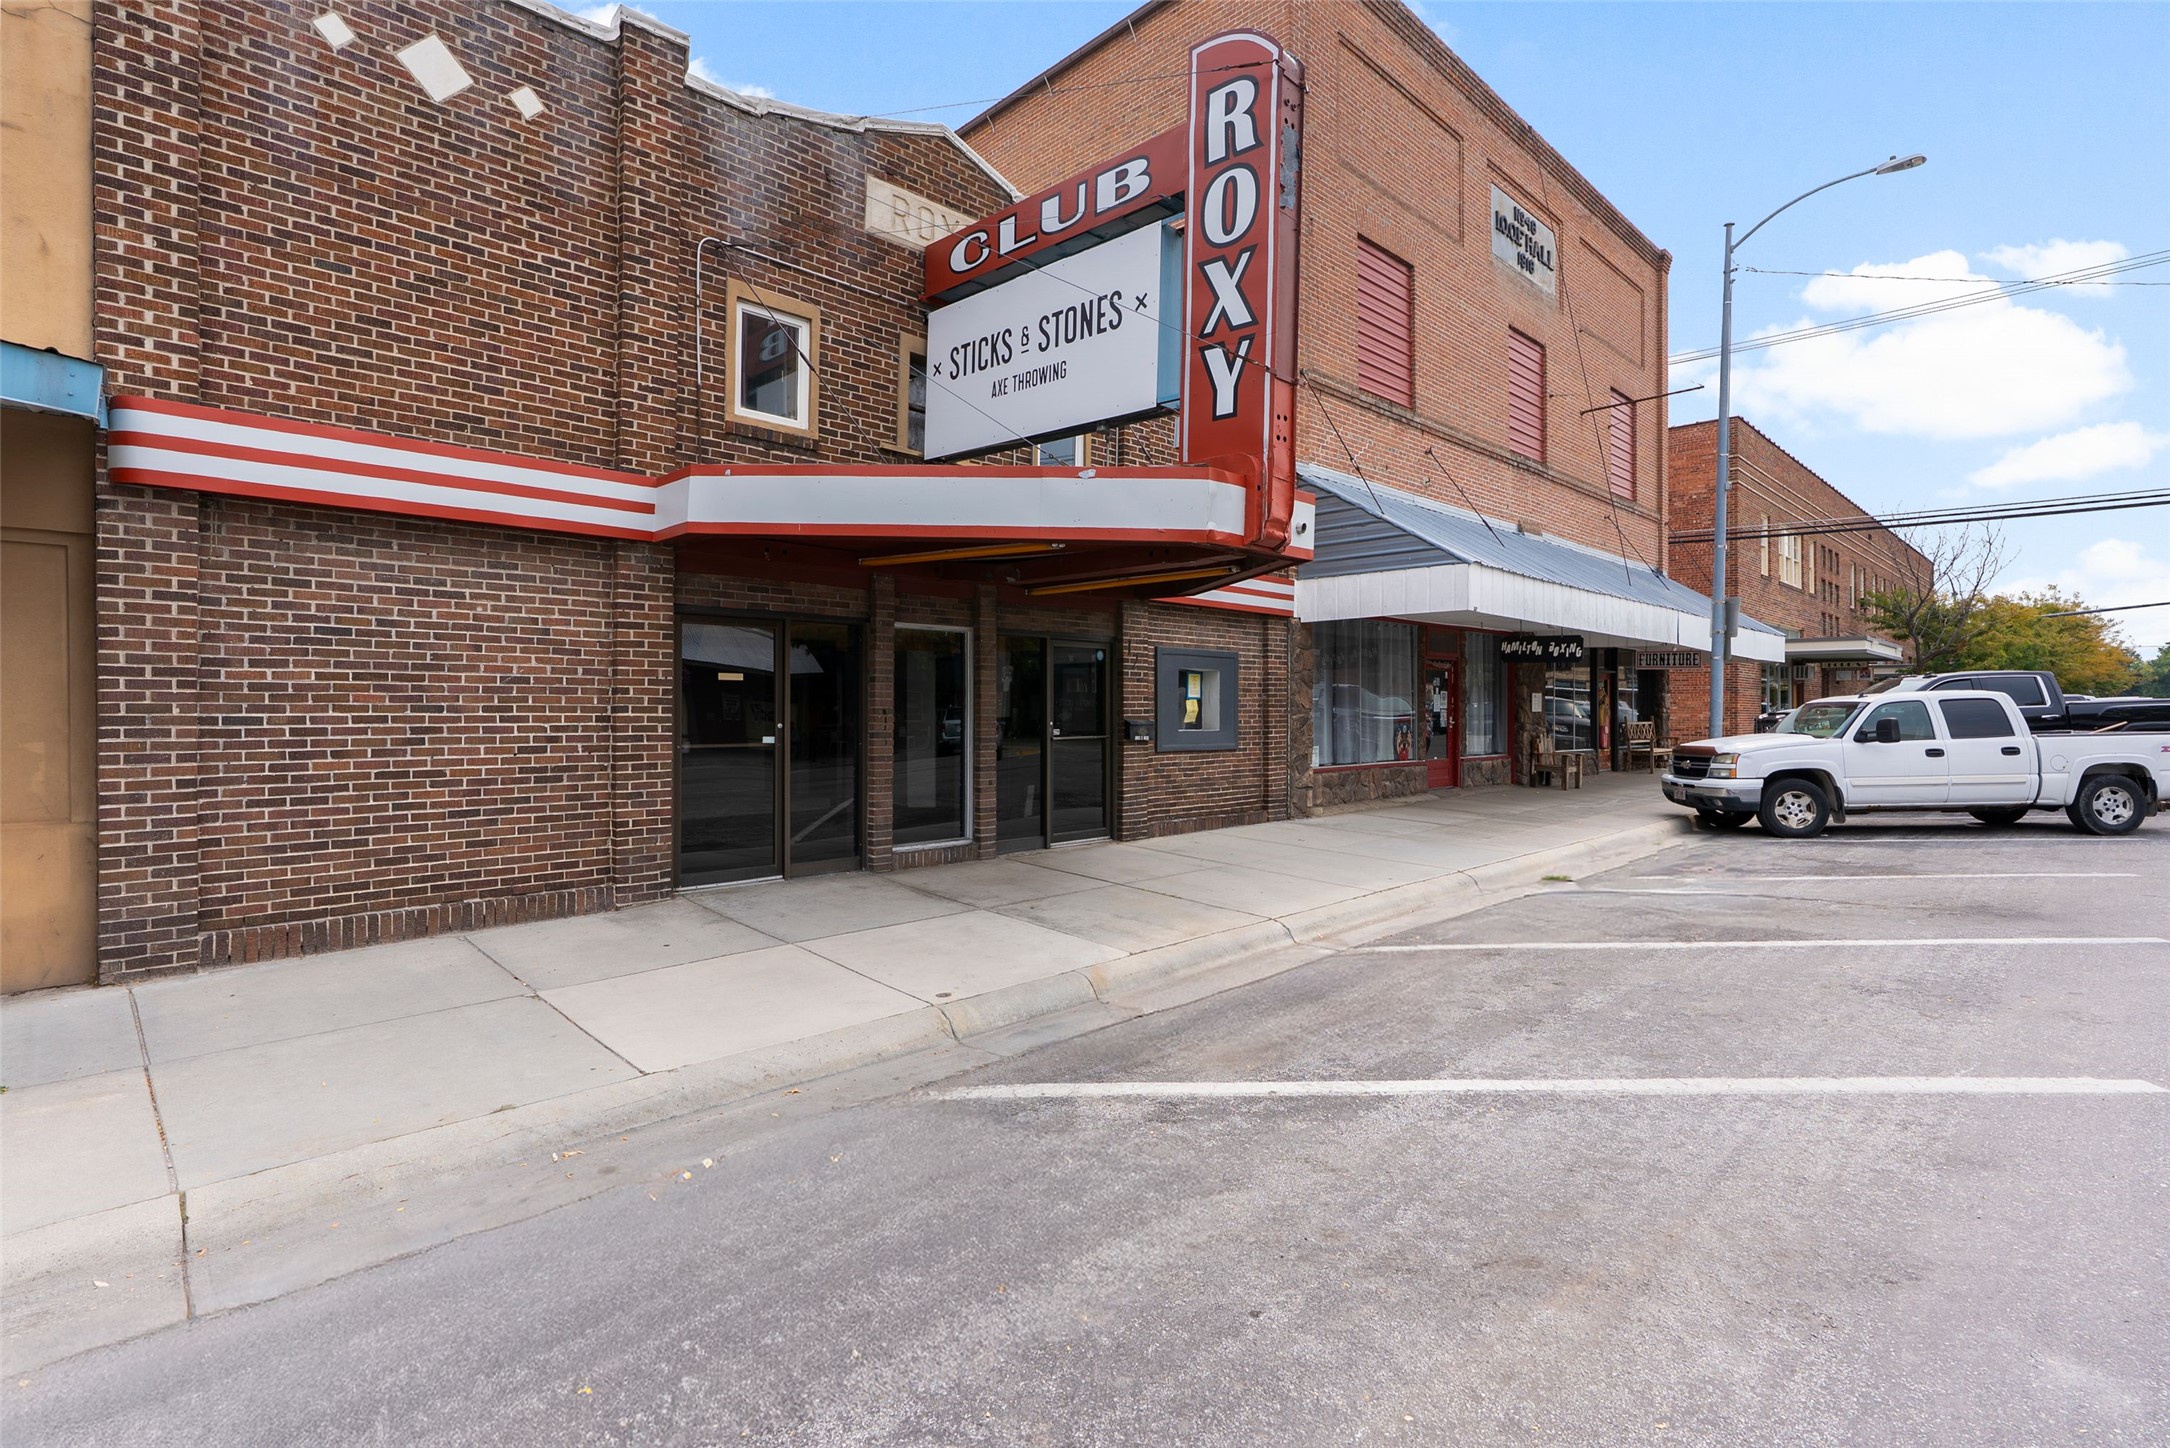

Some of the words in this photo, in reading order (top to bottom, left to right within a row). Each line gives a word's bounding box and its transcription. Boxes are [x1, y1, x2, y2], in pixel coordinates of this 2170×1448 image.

[949, 156, 1152, 274] CLUB
[1201, 76, 1263, 421] ROXY
[1524, 233, 1555, 272] HALL
[950, 328, 1012, 380] STICKS
[1038, 290, 1123, 352] STONES
[991, 377, 1008, 399] AXE
[1012, 360, 1067, 393] THROWING
[1501, 641, 1543, 656] HAMILTON
[1549, 642, 1583, 658] BOXING
[1638, 652, 1700, 667] FURNITURE
